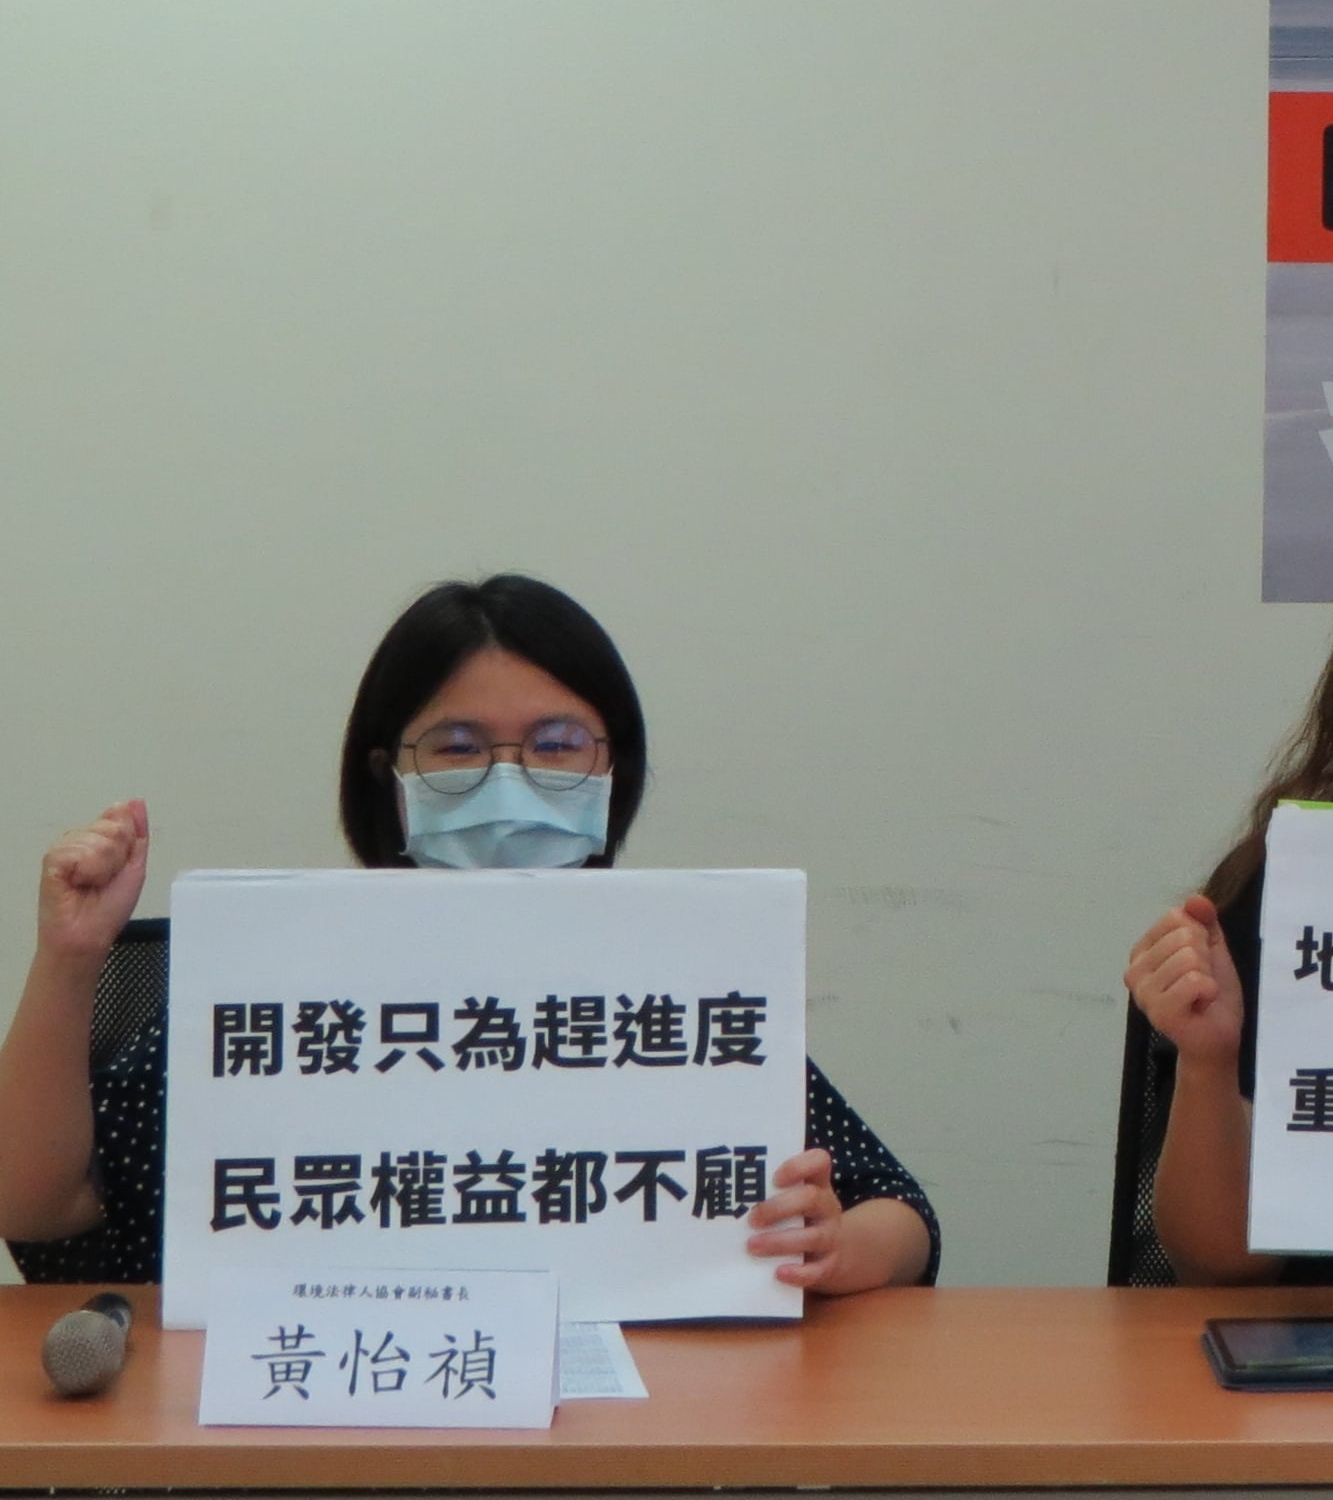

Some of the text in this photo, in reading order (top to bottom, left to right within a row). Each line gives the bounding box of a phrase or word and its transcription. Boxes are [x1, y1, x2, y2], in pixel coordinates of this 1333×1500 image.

[211, 991, 768, 1078] 開發只為趕進度
[209, 1145, 768, 1232] 民眾權益都不顧
